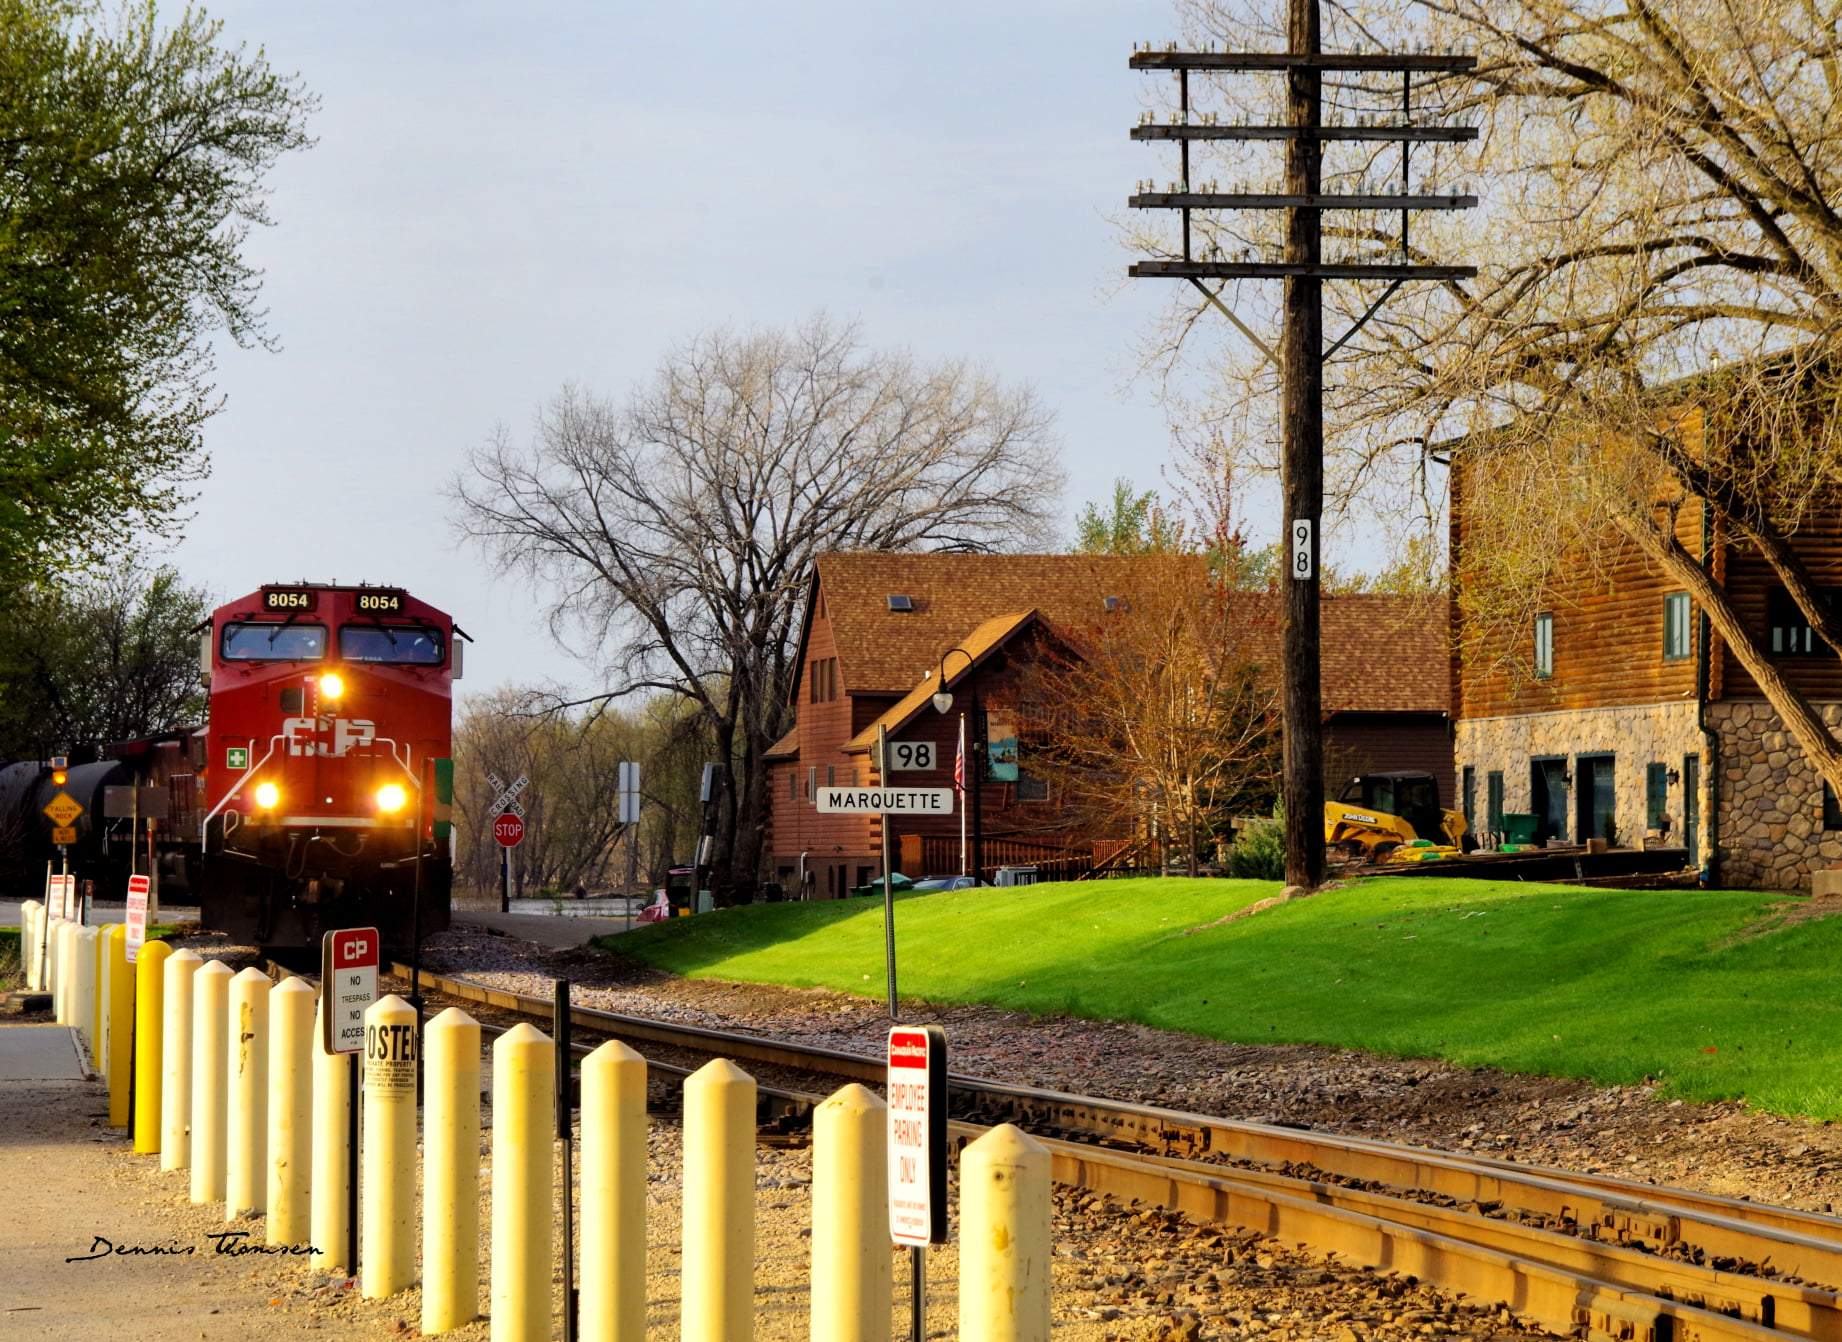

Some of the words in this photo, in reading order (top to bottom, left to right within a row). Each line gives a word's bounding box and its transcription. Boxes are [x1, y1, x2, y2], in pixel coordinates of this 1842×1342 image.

[268, 593, 308, 607] 8054
[360, 595, 399, 609] 8054
[898, 744, 930, 768] 98
[490, 777, 528, 814] CROSSING
[829, 792, 941, 809] MARQUETTE
[495, 823, 522, 837] STOP
[344, 940, 368, 960] CP
[350, 975, 361, 986] NO
[341, 993, 370, 1004] TRESPASS
[350, 1010, 361, 1020] NO
[341, 1026, 365, 1039] ACCES
[892, 1083, 925, 1112] EMPLOYEE
[894, 1119, 922, 1148] PARKING
[900, 1156, 917, 1184] ONLY
